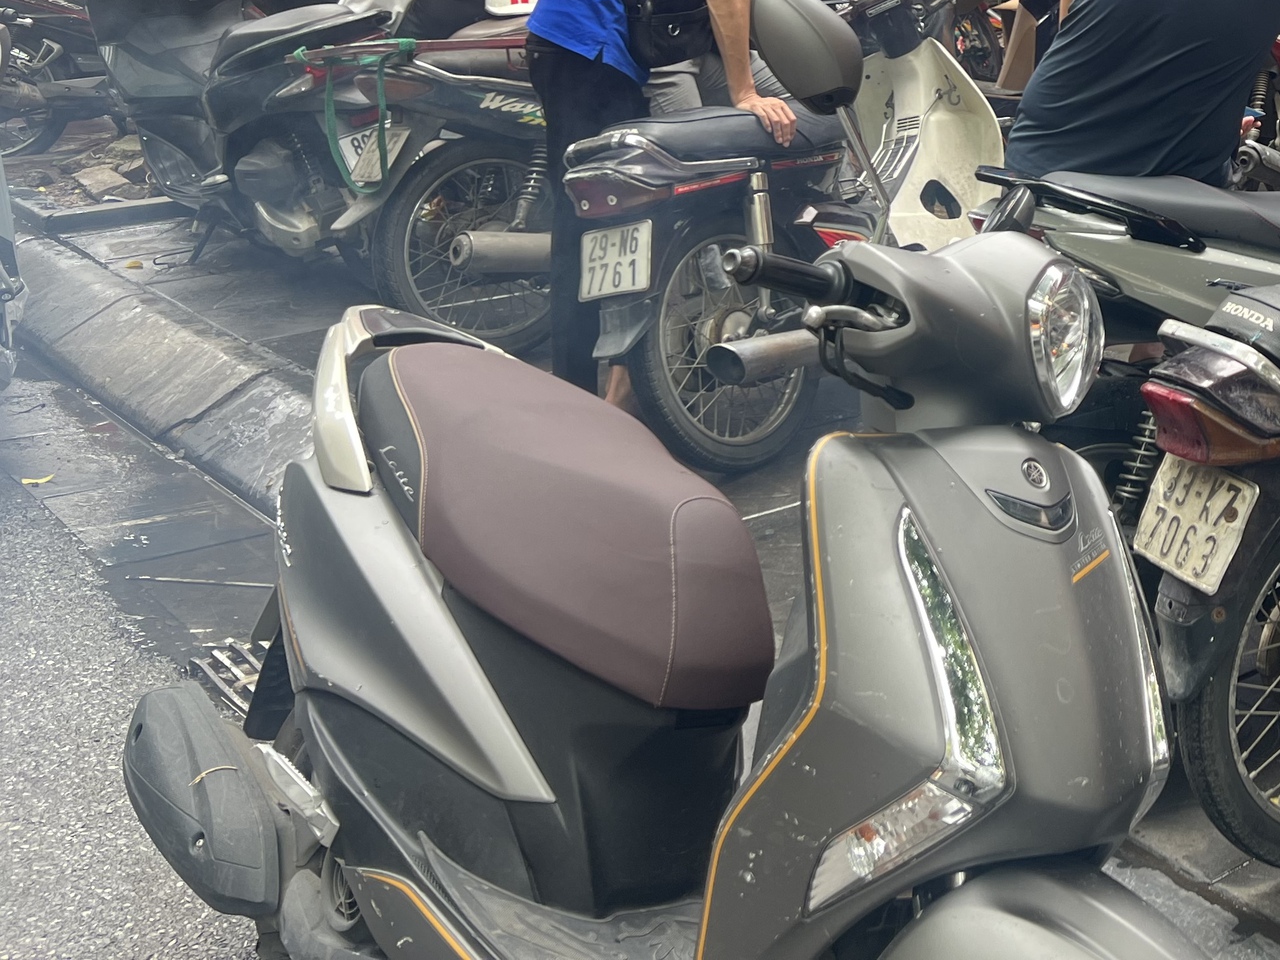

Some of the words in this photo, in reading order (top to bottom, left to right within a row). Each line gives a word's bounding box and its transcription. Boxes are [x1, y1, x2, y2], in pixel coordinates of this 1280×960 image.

[797, 155, 824, 165] HONDA
[588, 226, 640, 264] 29-N6
[587, 258, 638, 296] 7761
[1222, 301, 1275, 332] HONDA
[1144, 504, 1218, 579] 7063
